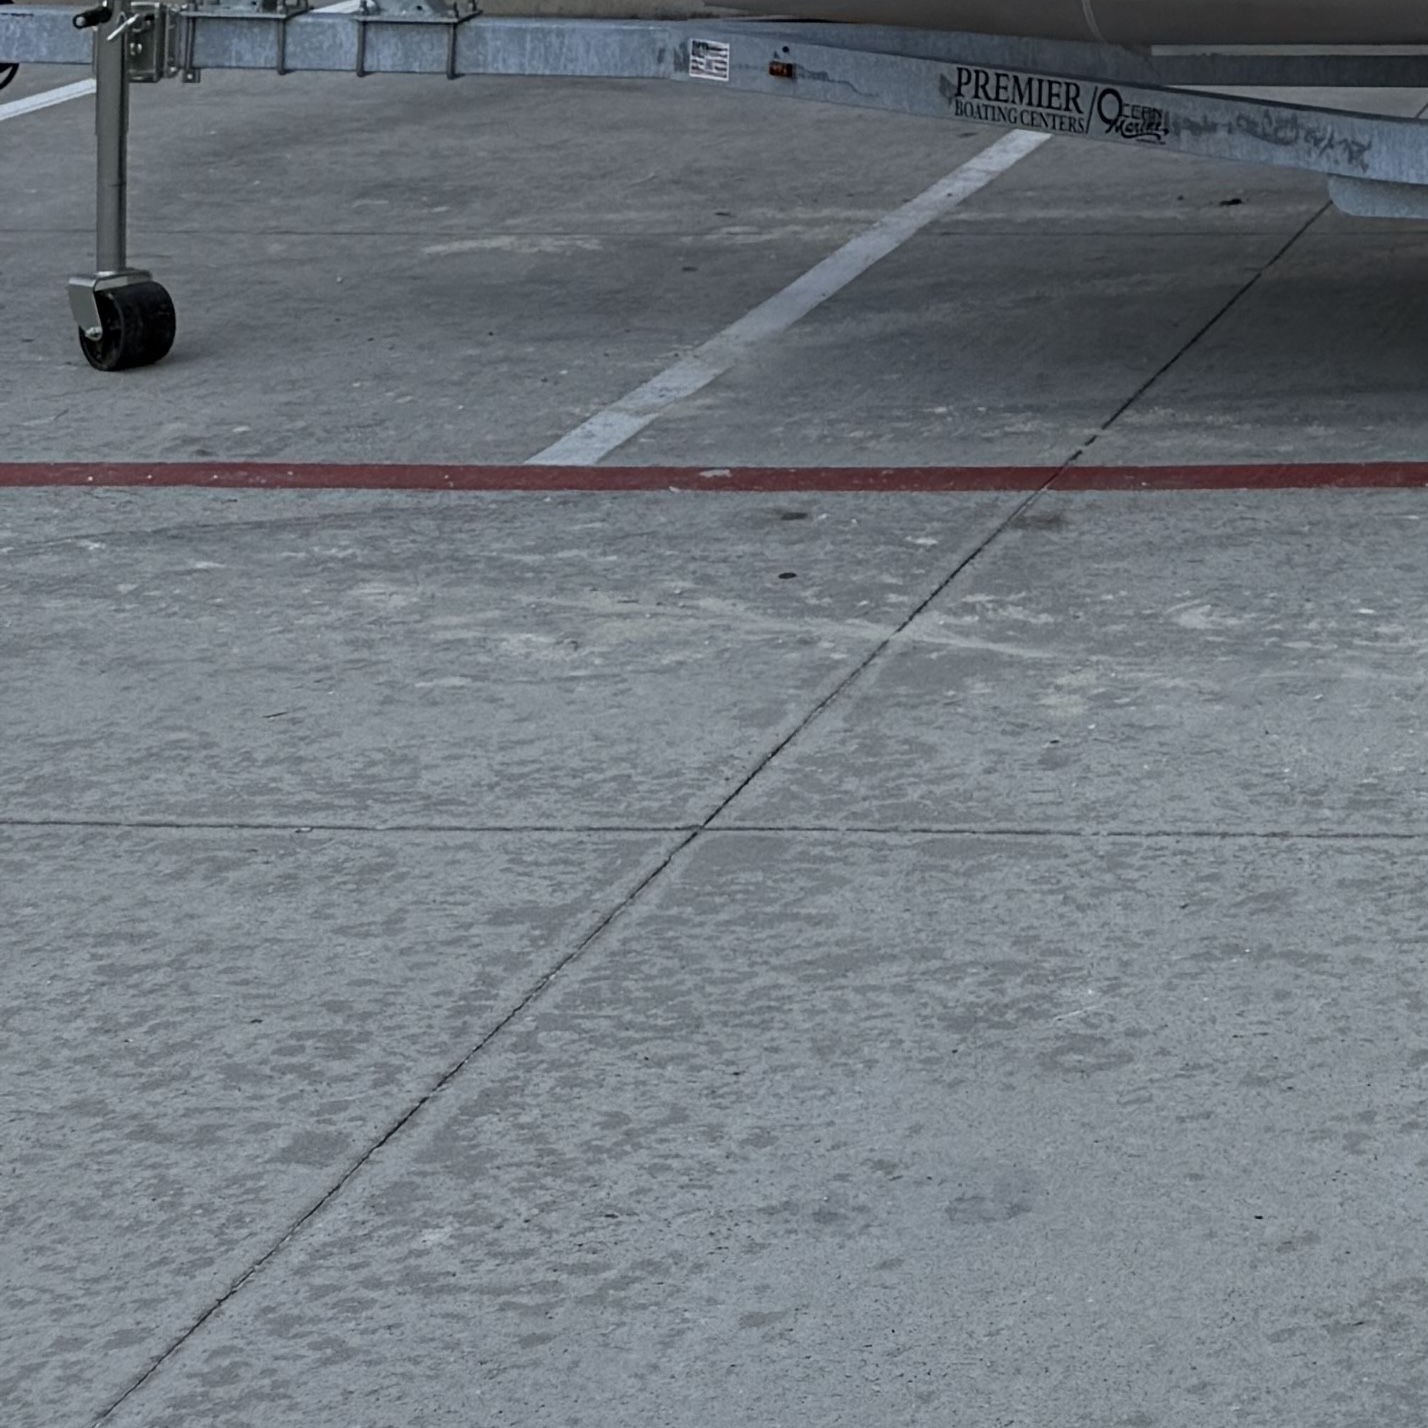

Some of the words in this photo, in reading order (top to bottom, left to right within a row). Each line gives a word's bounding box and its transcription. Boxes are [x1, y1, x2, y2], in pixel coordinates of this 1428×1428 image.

[954, 66, 1084, 114] PREMIER
[953, 99, 1018, 125] BOATING
[1019, 109, 1086, 134] CENTERS
